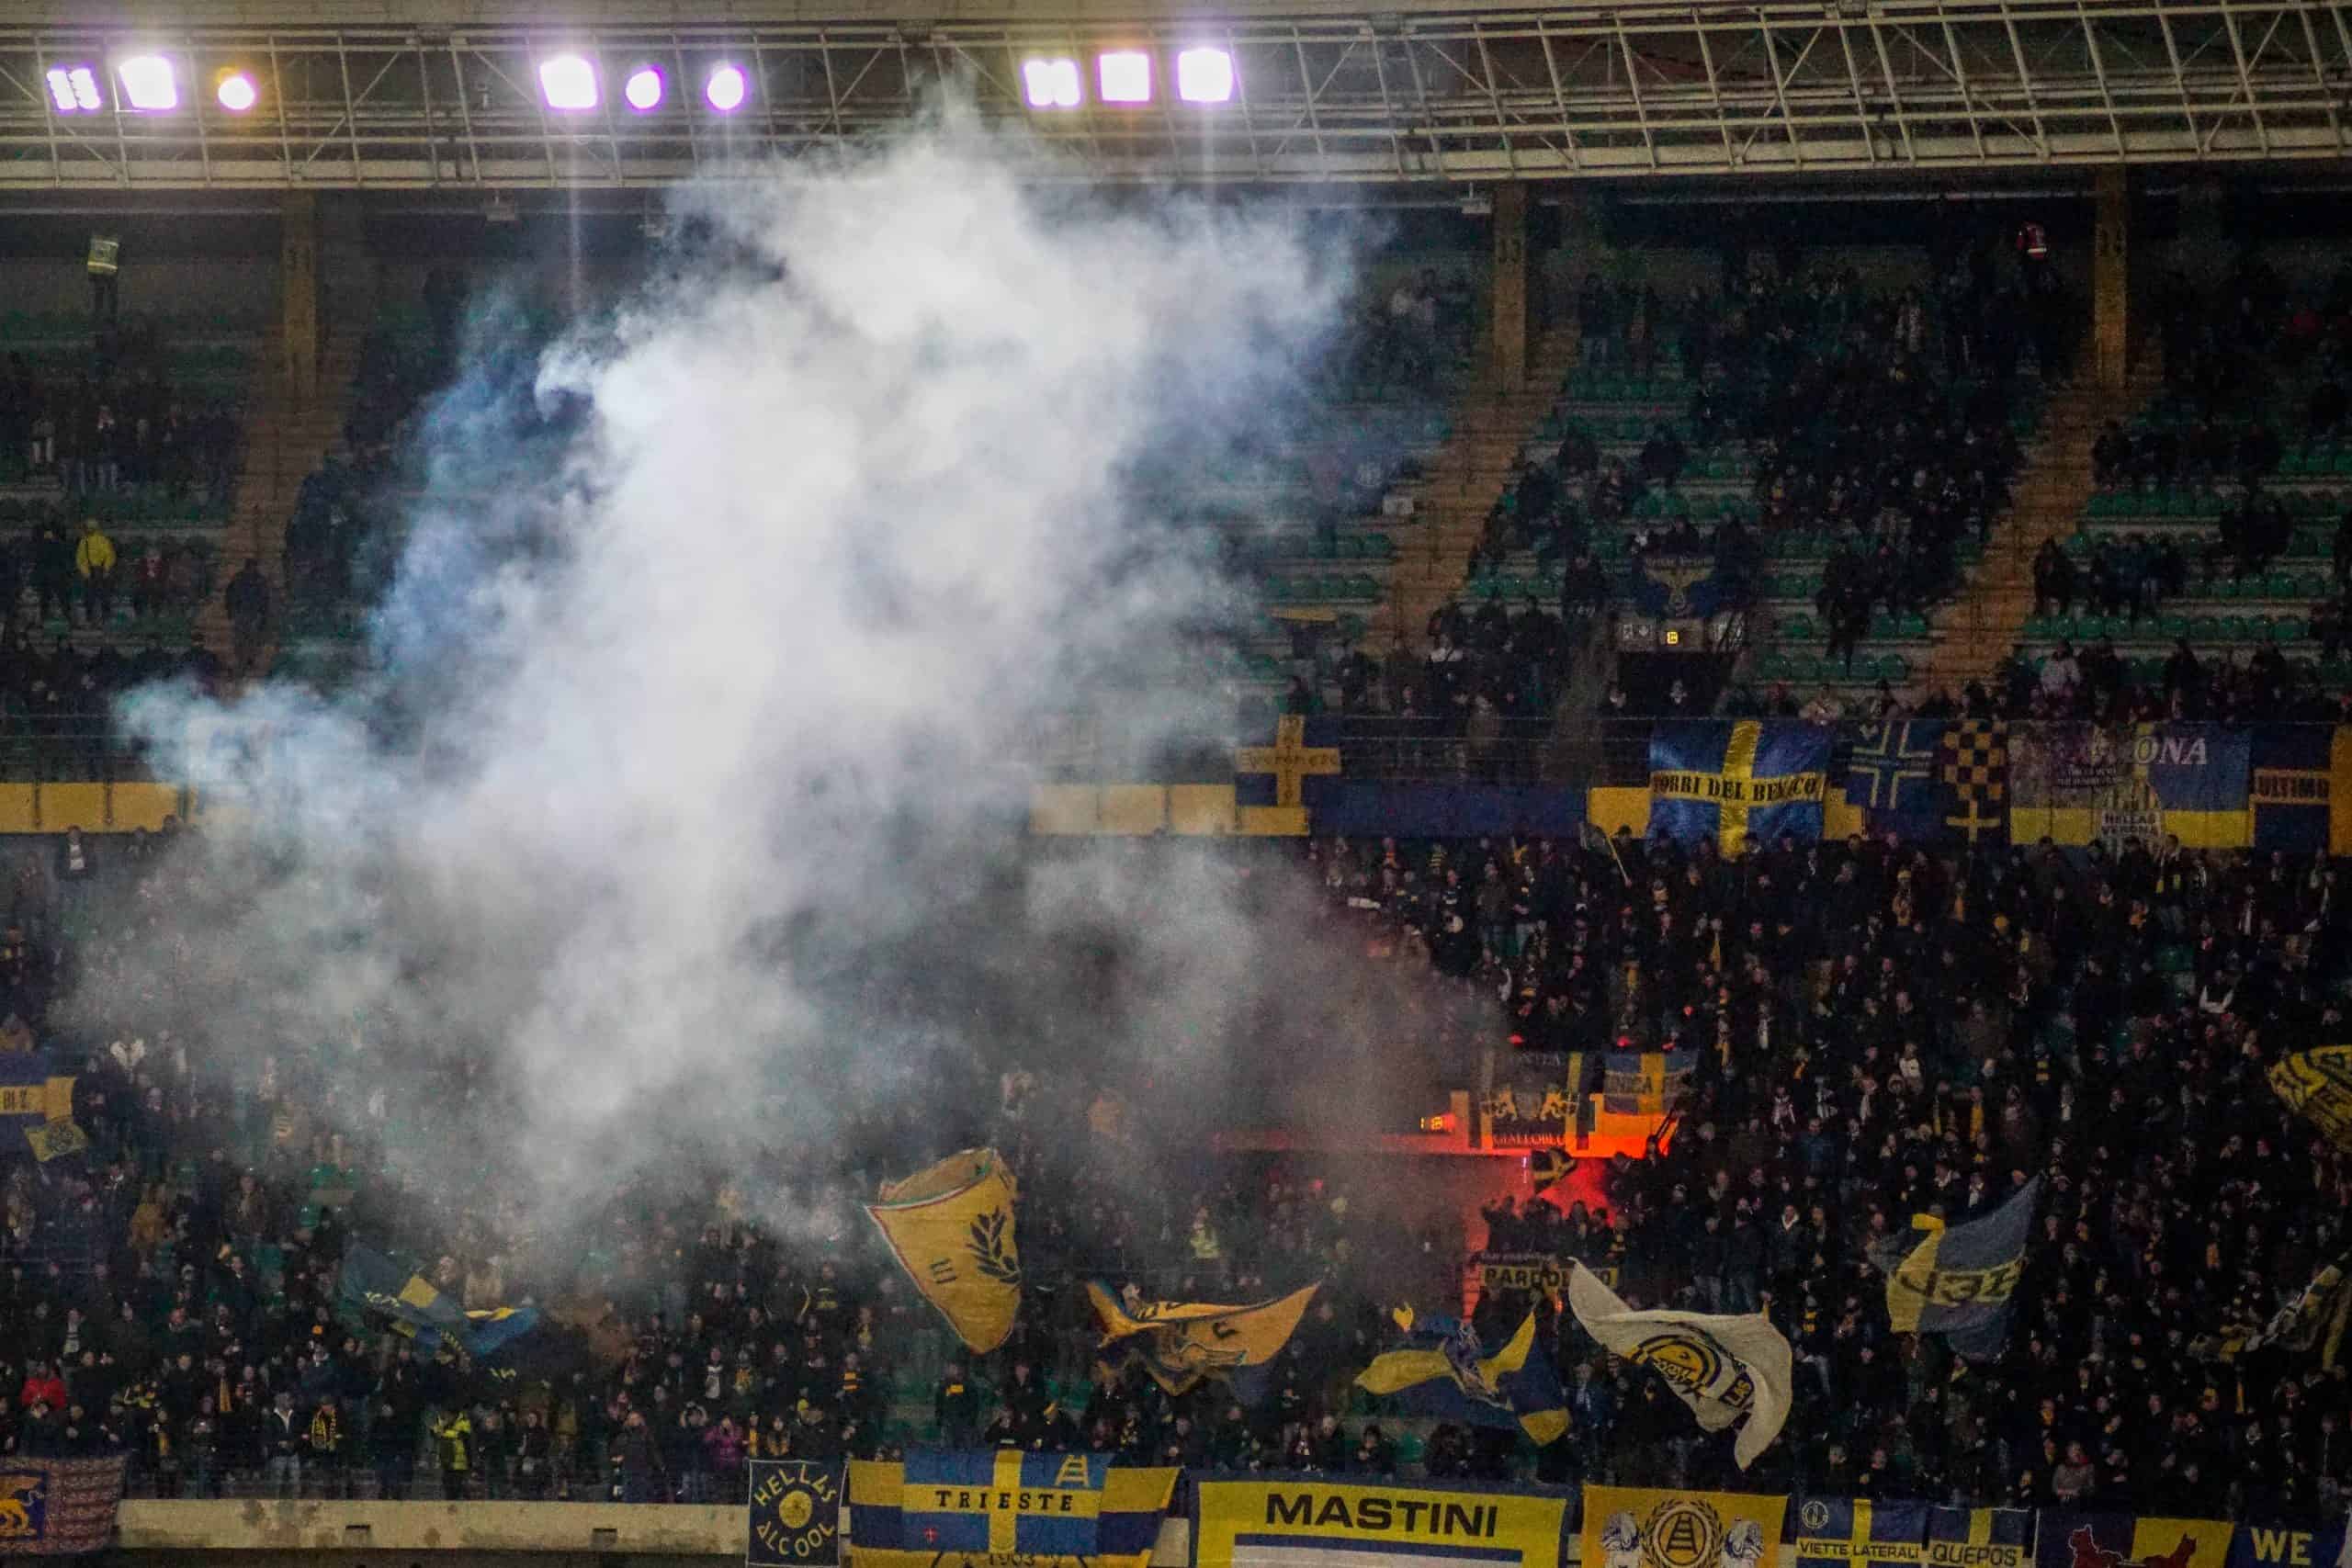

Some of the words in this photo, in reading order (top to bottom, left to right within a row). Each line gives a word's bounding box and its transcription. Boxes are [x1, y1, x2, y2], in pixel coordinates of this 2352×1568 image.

[1708, 779, 1745, 799] DEL
[753, 1464, 837, 1506] HELLAS
[935, 1490, 1073, 1511] TRIESTE
[1266, 1494, 1498, 1538] MASTINI
[756, 1520, 835, 1557] ALCOOL
[1800, 1542, 1848, 1556] VIETTE
[1853, 1545, 1919, 1559] LATERALI
[2251, 1528, 2312, 1566] WE
[1933, 1543, 2018, 1566] QUEPOS
